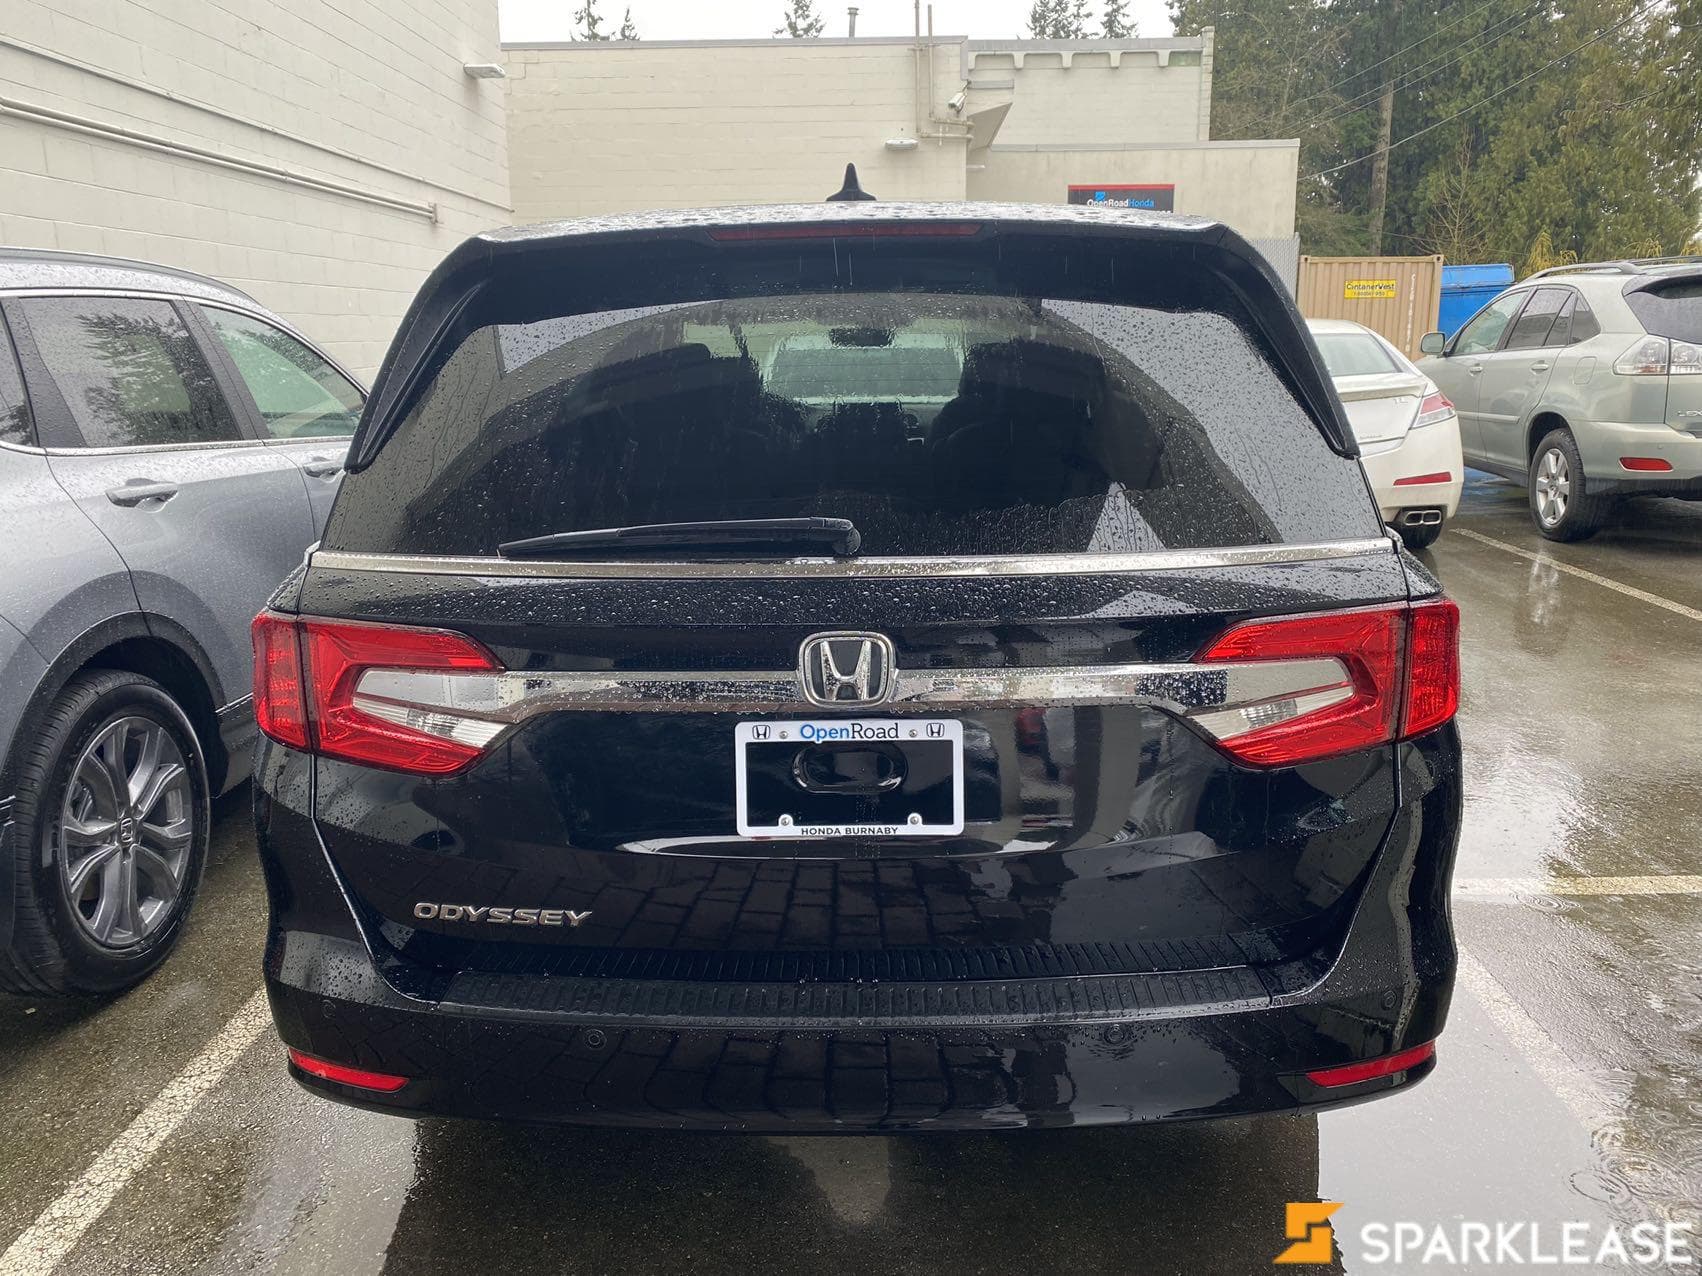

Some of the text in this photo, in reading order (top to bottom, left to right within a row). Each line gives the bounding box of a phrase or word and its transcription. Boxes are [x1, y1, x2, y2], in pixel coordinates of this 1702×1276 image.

[800, 723, 900, 742] OpenRoad
[801, 827, 899, 835] HONDA BURNABY
[413, 902, 592, 927] ODYSSEY
